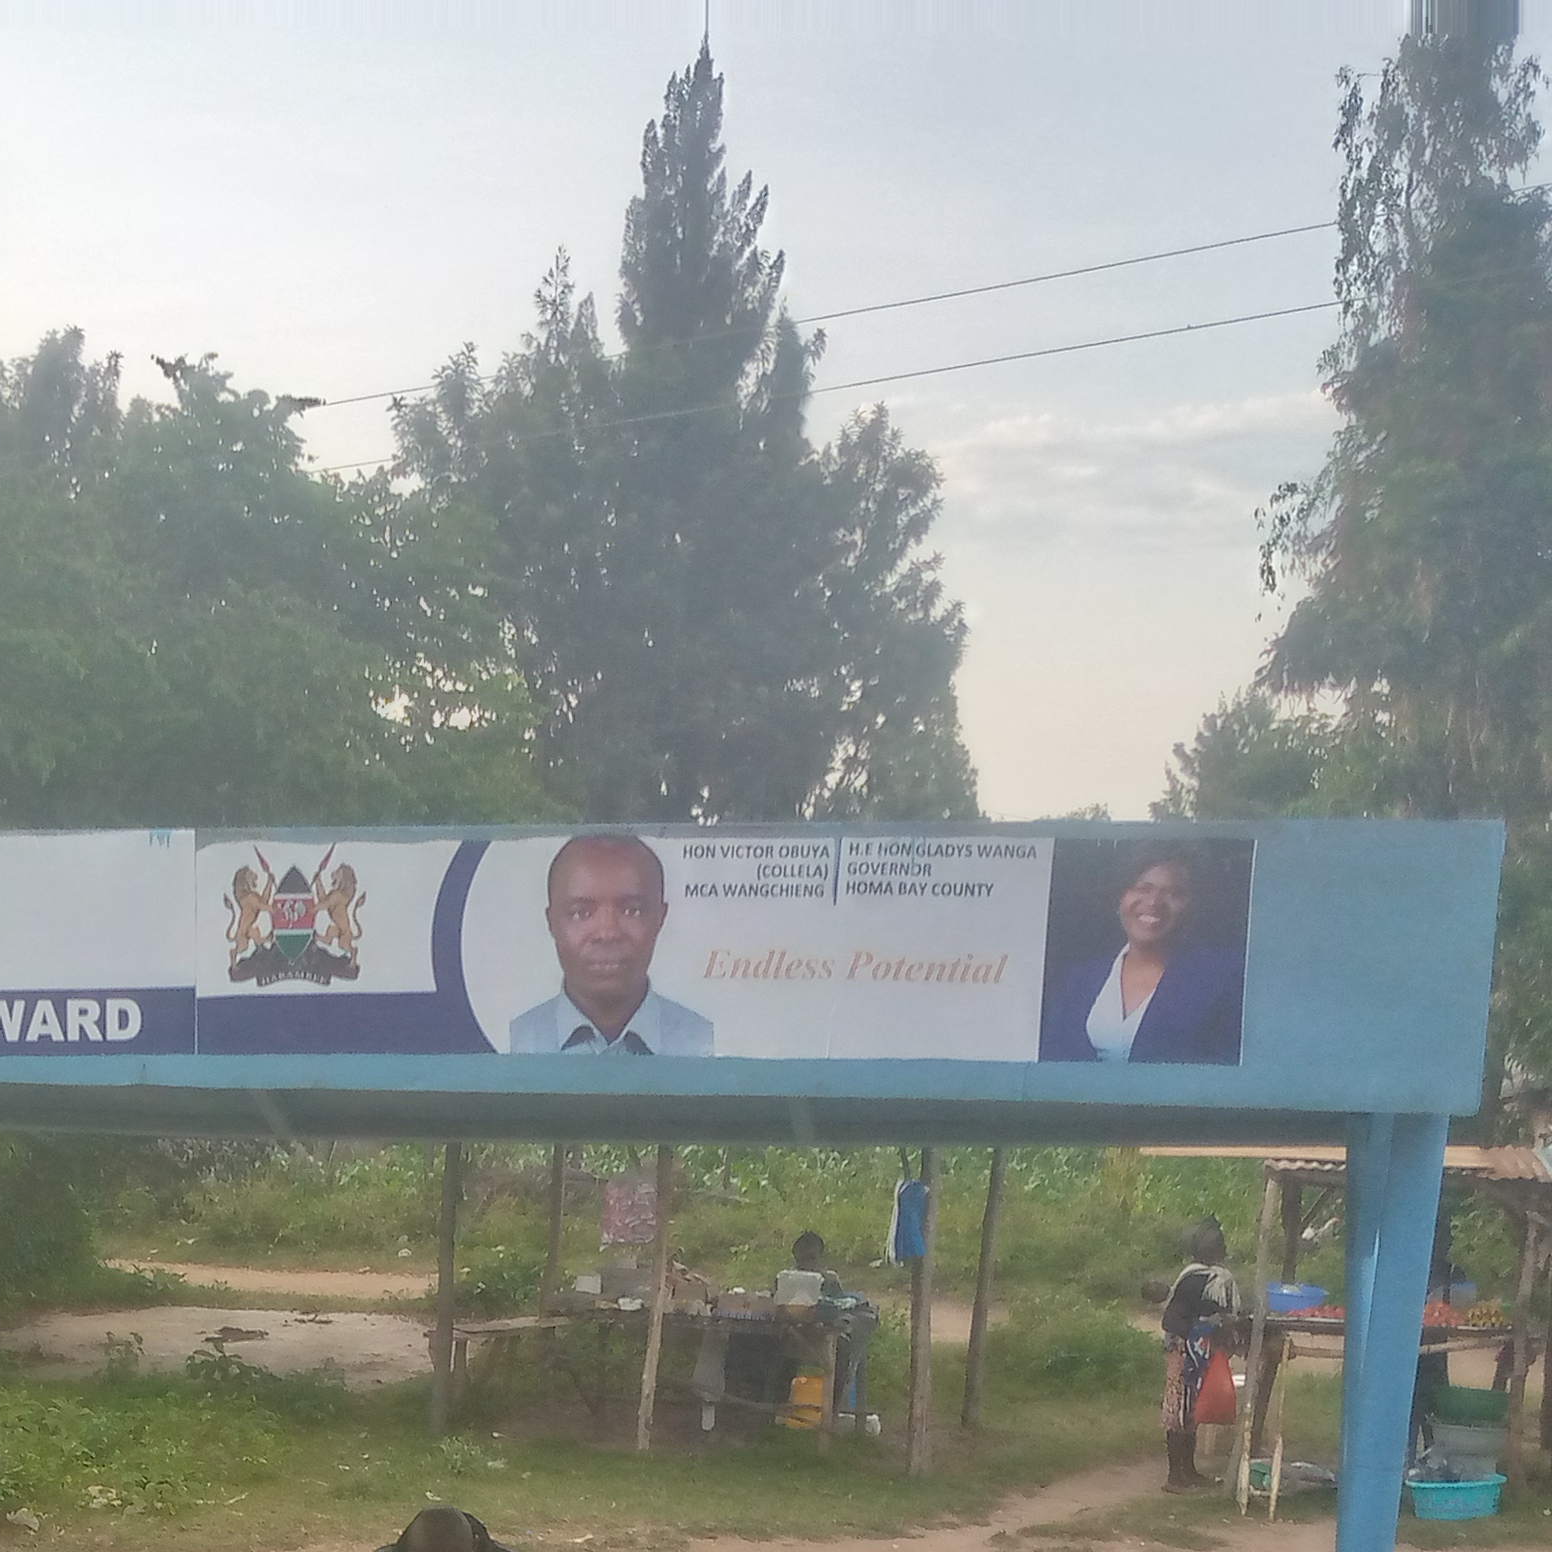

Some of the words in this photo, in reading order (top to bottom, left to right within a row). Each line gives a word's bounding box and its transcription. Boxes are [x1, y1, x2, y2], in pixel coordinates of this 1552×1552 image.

[682, 844, 716, 860] HON
[719, 844, 774, 860] VICTOR
[778, 844, 830, 860] OBUYA
[877, 842, 912, 858] HON
[915, 842, 973, 859] GLADYS
[977, 844, 1037, 859] WANGA
[756, 862, 829, 882] (COLLELA)
[847, 861, 932, 878] GOVERNOR
[684, 882, 719, 898] MCA
[722, 882, 825, 898] WANGCHIENG
[845, 880, 894, 896] HOMA
[897, 882, 928, 897] BAY
[931, 882, 994, 897] COUNTY
[703, 949, 835, 980] Endless
[846, 950, 1009, 984] Potential
